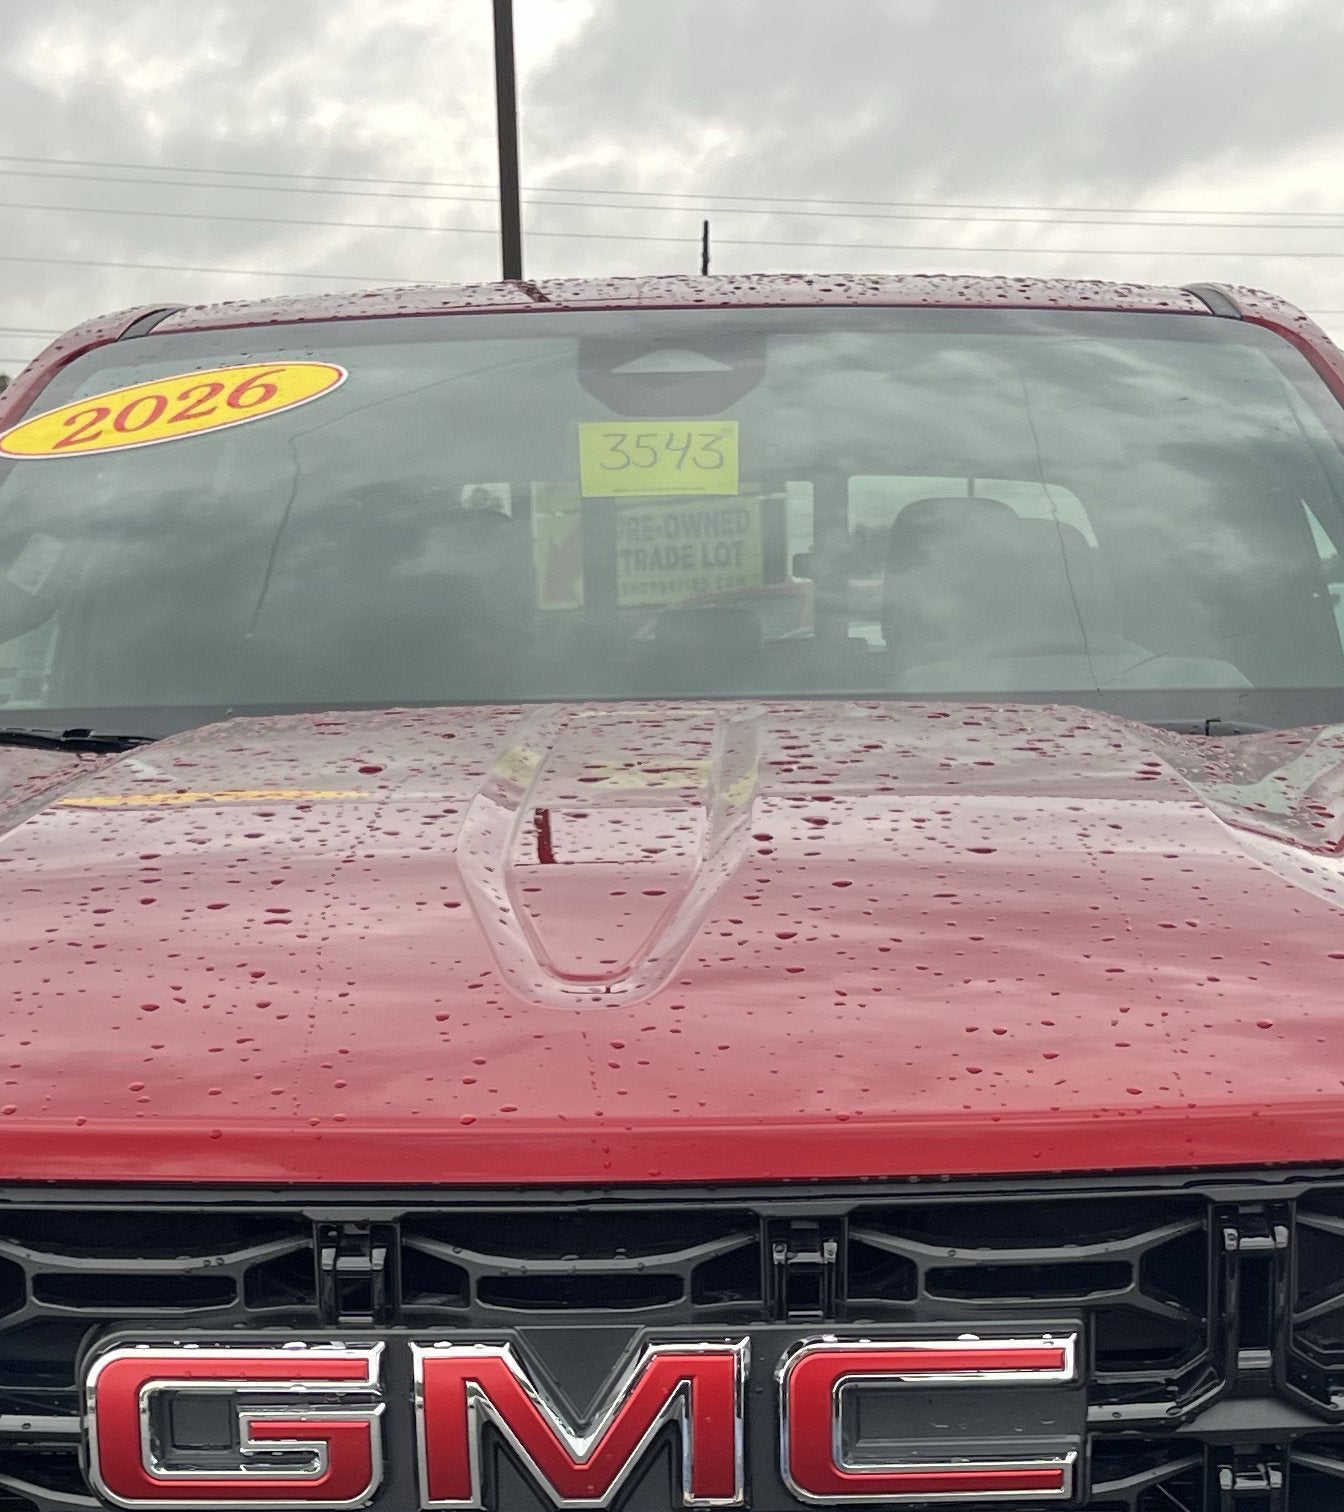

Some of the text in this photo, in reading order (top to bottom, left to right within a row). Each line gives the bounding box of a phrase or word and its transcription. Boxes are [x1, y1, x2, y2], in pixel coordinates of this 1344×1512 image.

[51, 368, 287, 450] 2026
[599, 431, 726, 471] 3543
[620, 540, 745, 573] TRADE LOT
[85, 1333, 1078, 1511] GMC
